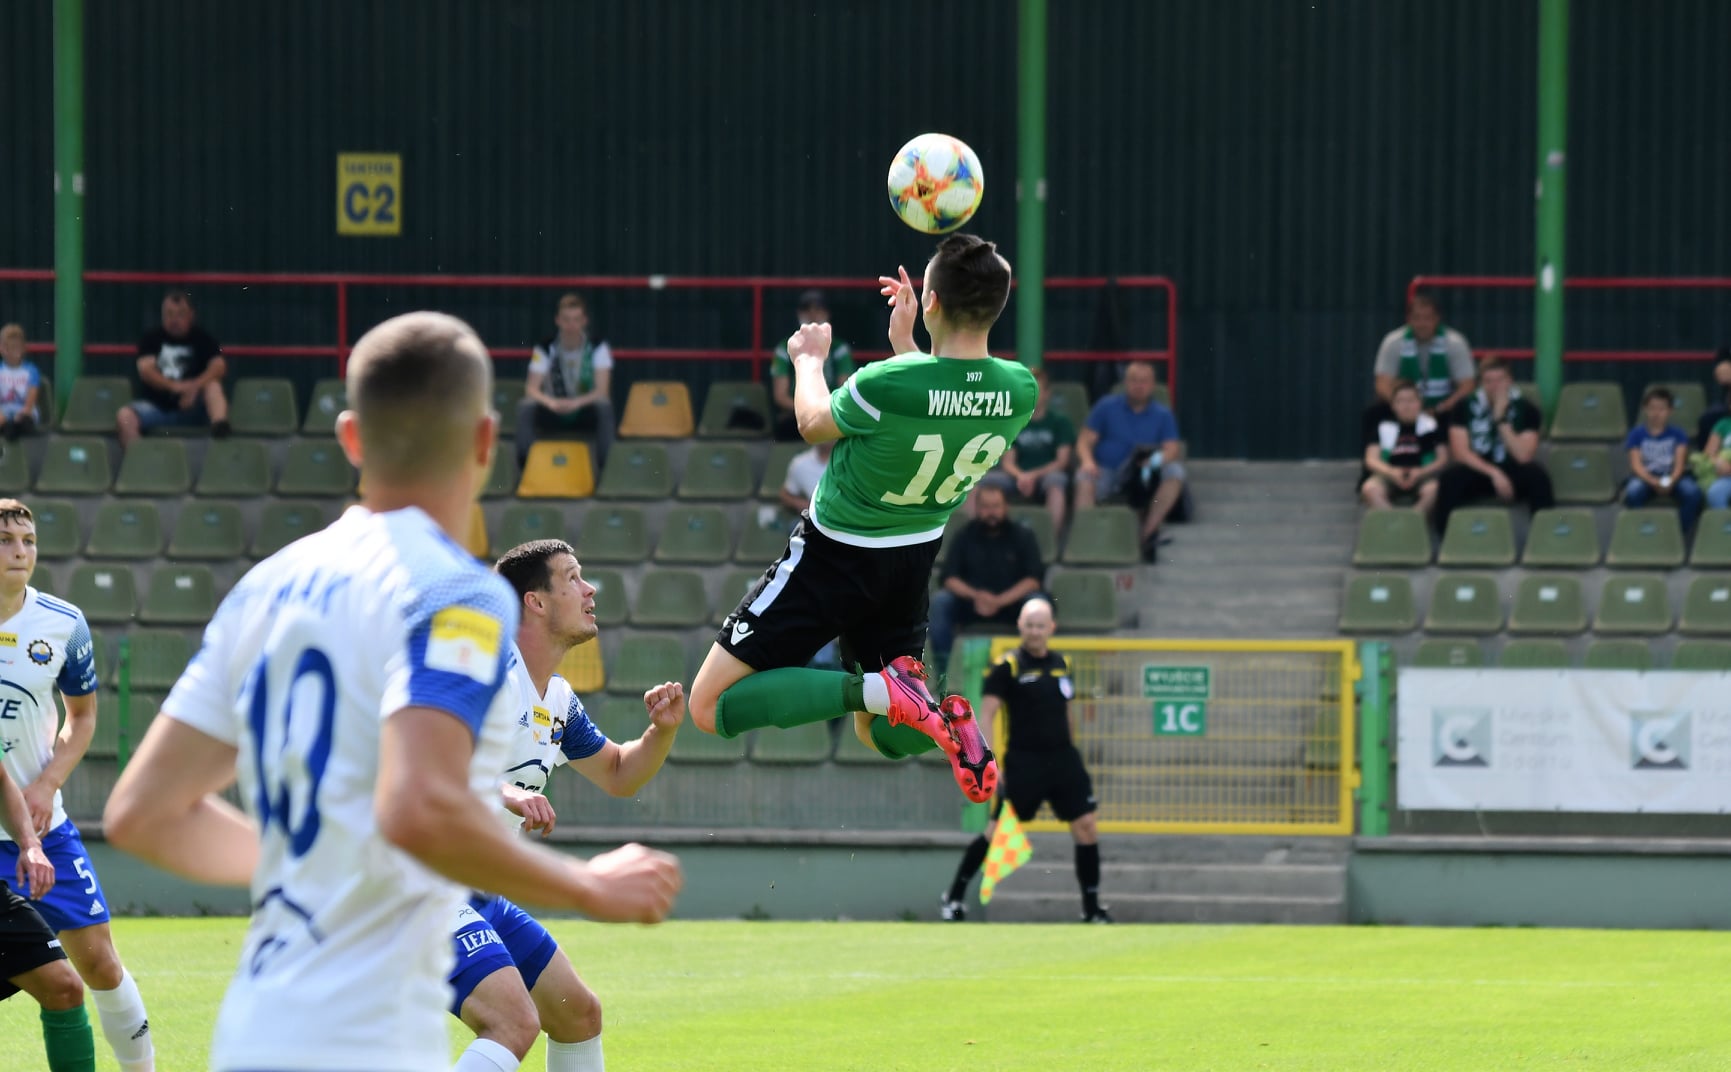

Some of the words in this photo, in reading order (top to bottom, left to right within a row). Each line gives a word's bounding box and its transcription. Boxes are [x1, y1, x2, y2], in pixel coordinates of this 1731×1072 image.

[344, 182, 395, 224] C2
[966, 371, 983, 382] 1977
[928, 389, 1013, 417] WINSZTAL
[880, 433, 1006, 505] 18
[1161, 704, 1200, 732] 1C
[73, 856, 97, 895] 5
